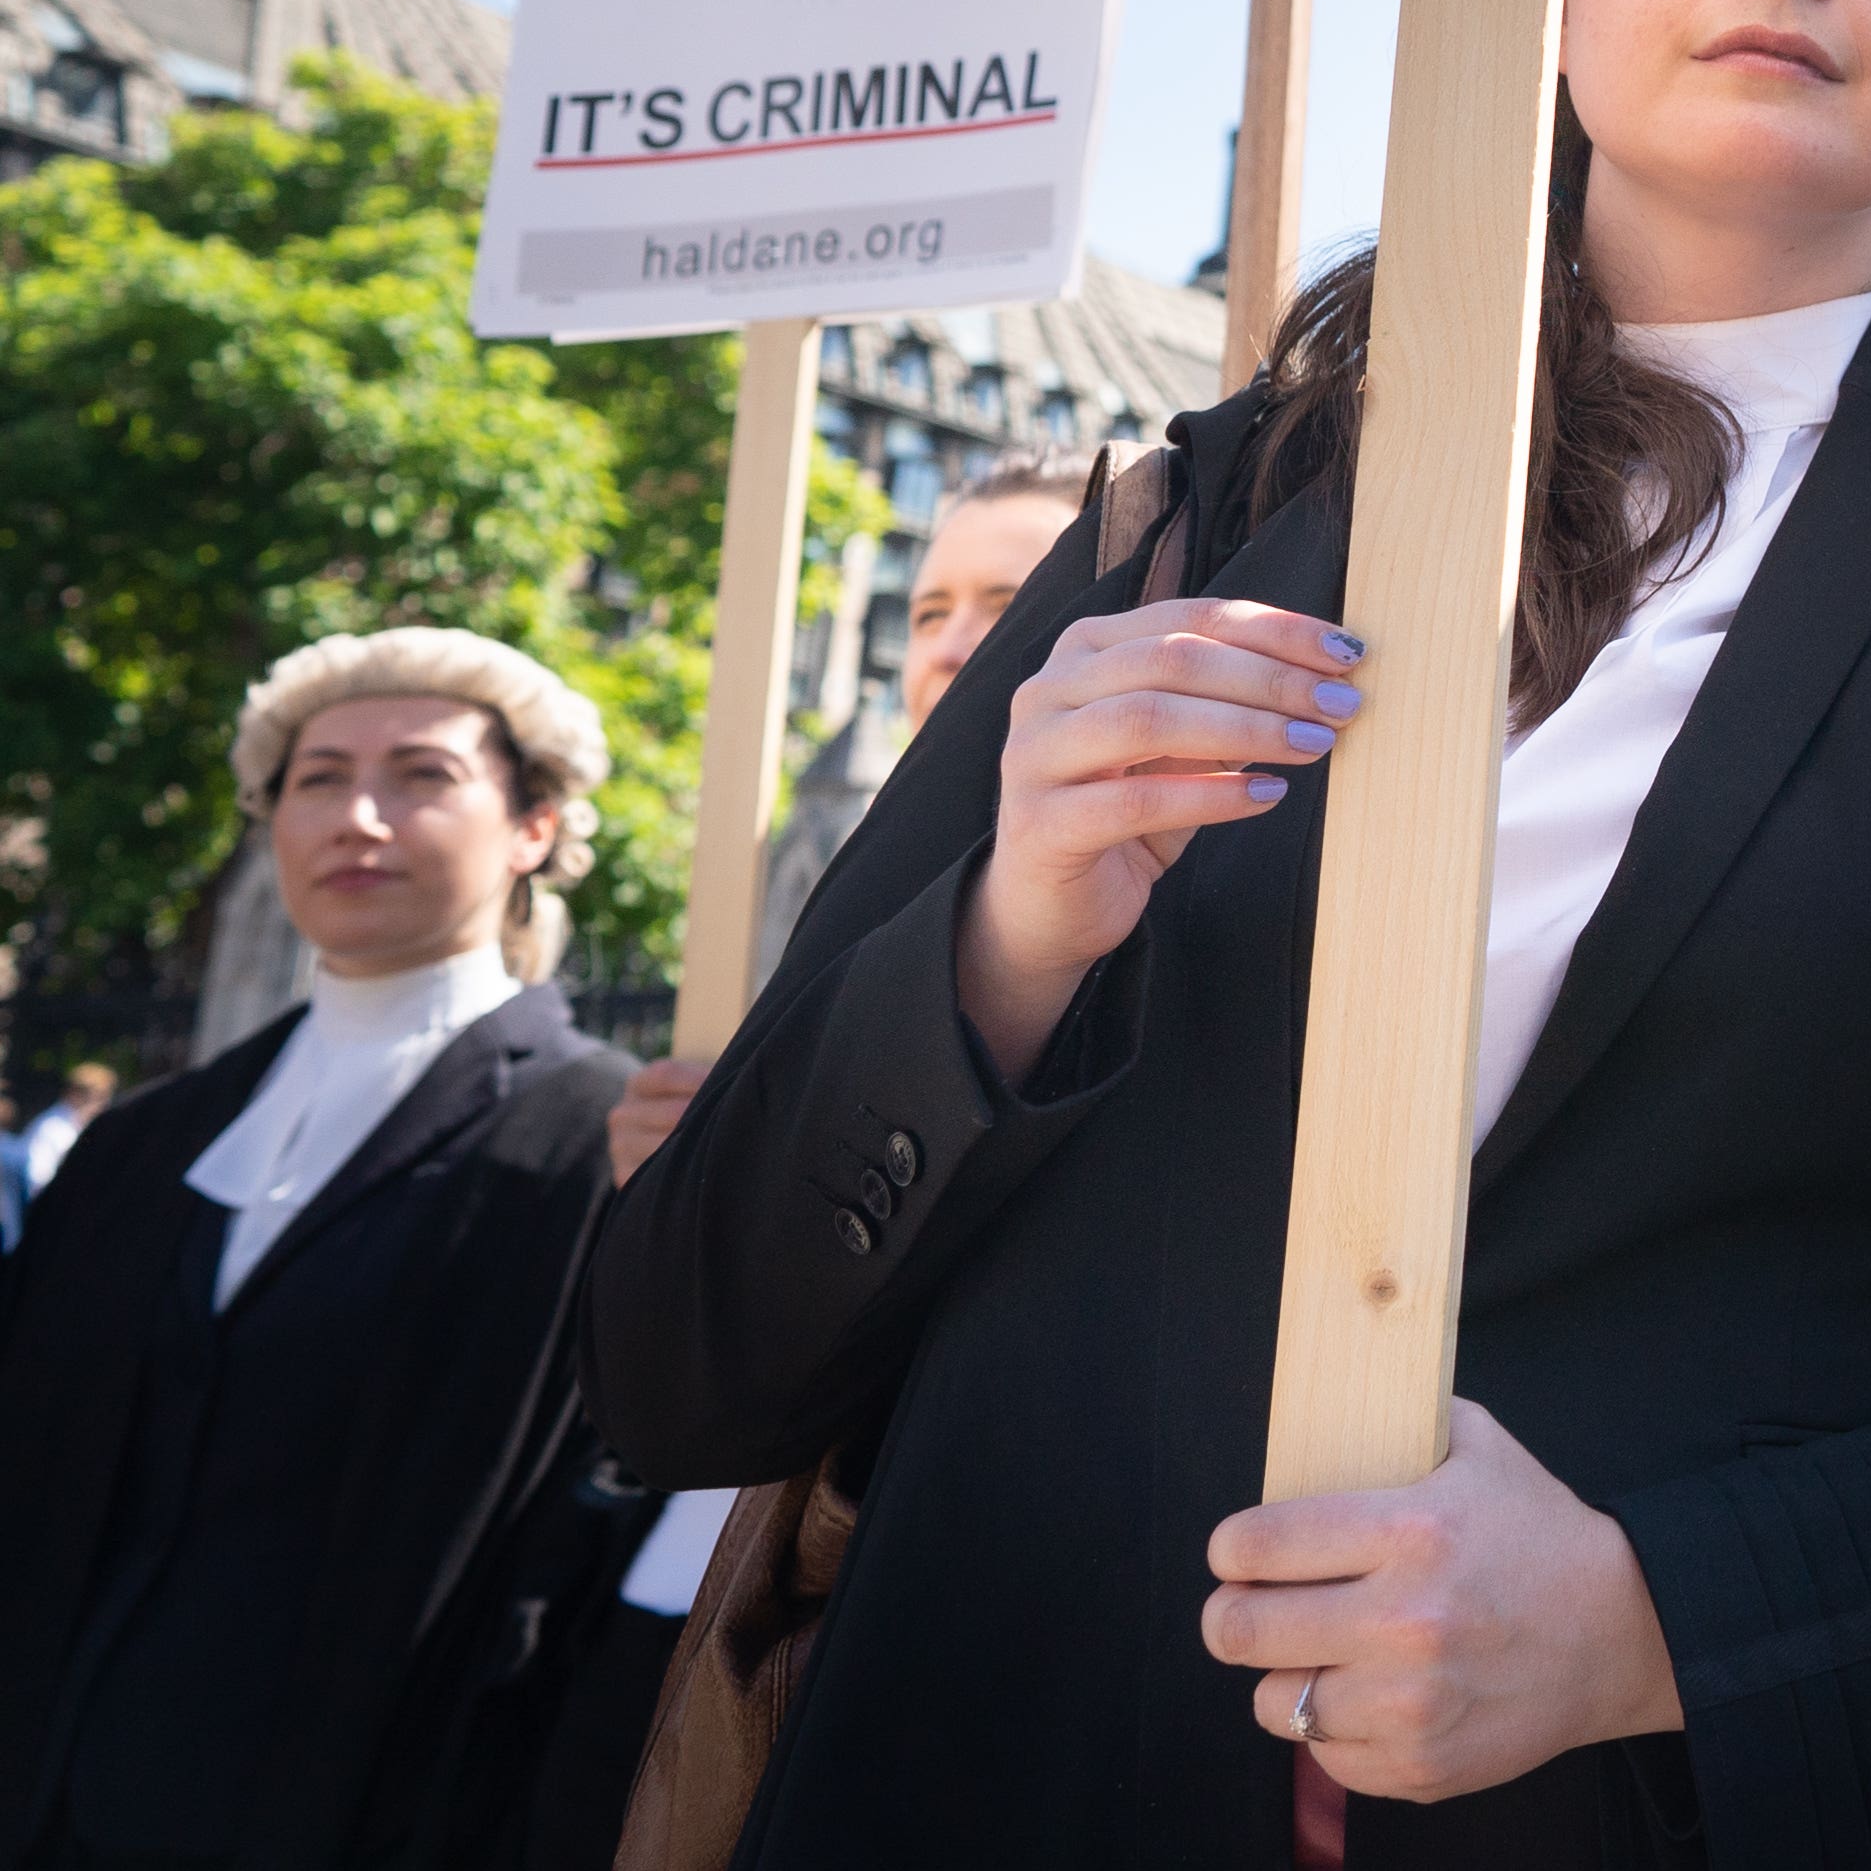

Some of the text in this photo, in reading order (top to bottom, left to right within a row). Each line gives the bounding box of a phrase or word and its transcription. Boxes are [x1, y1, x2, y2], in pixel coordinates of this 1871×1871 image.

[544, 52, 1057, 154] IT’S CRIMINAL
[642, 220, 943, 279] haldane.org
